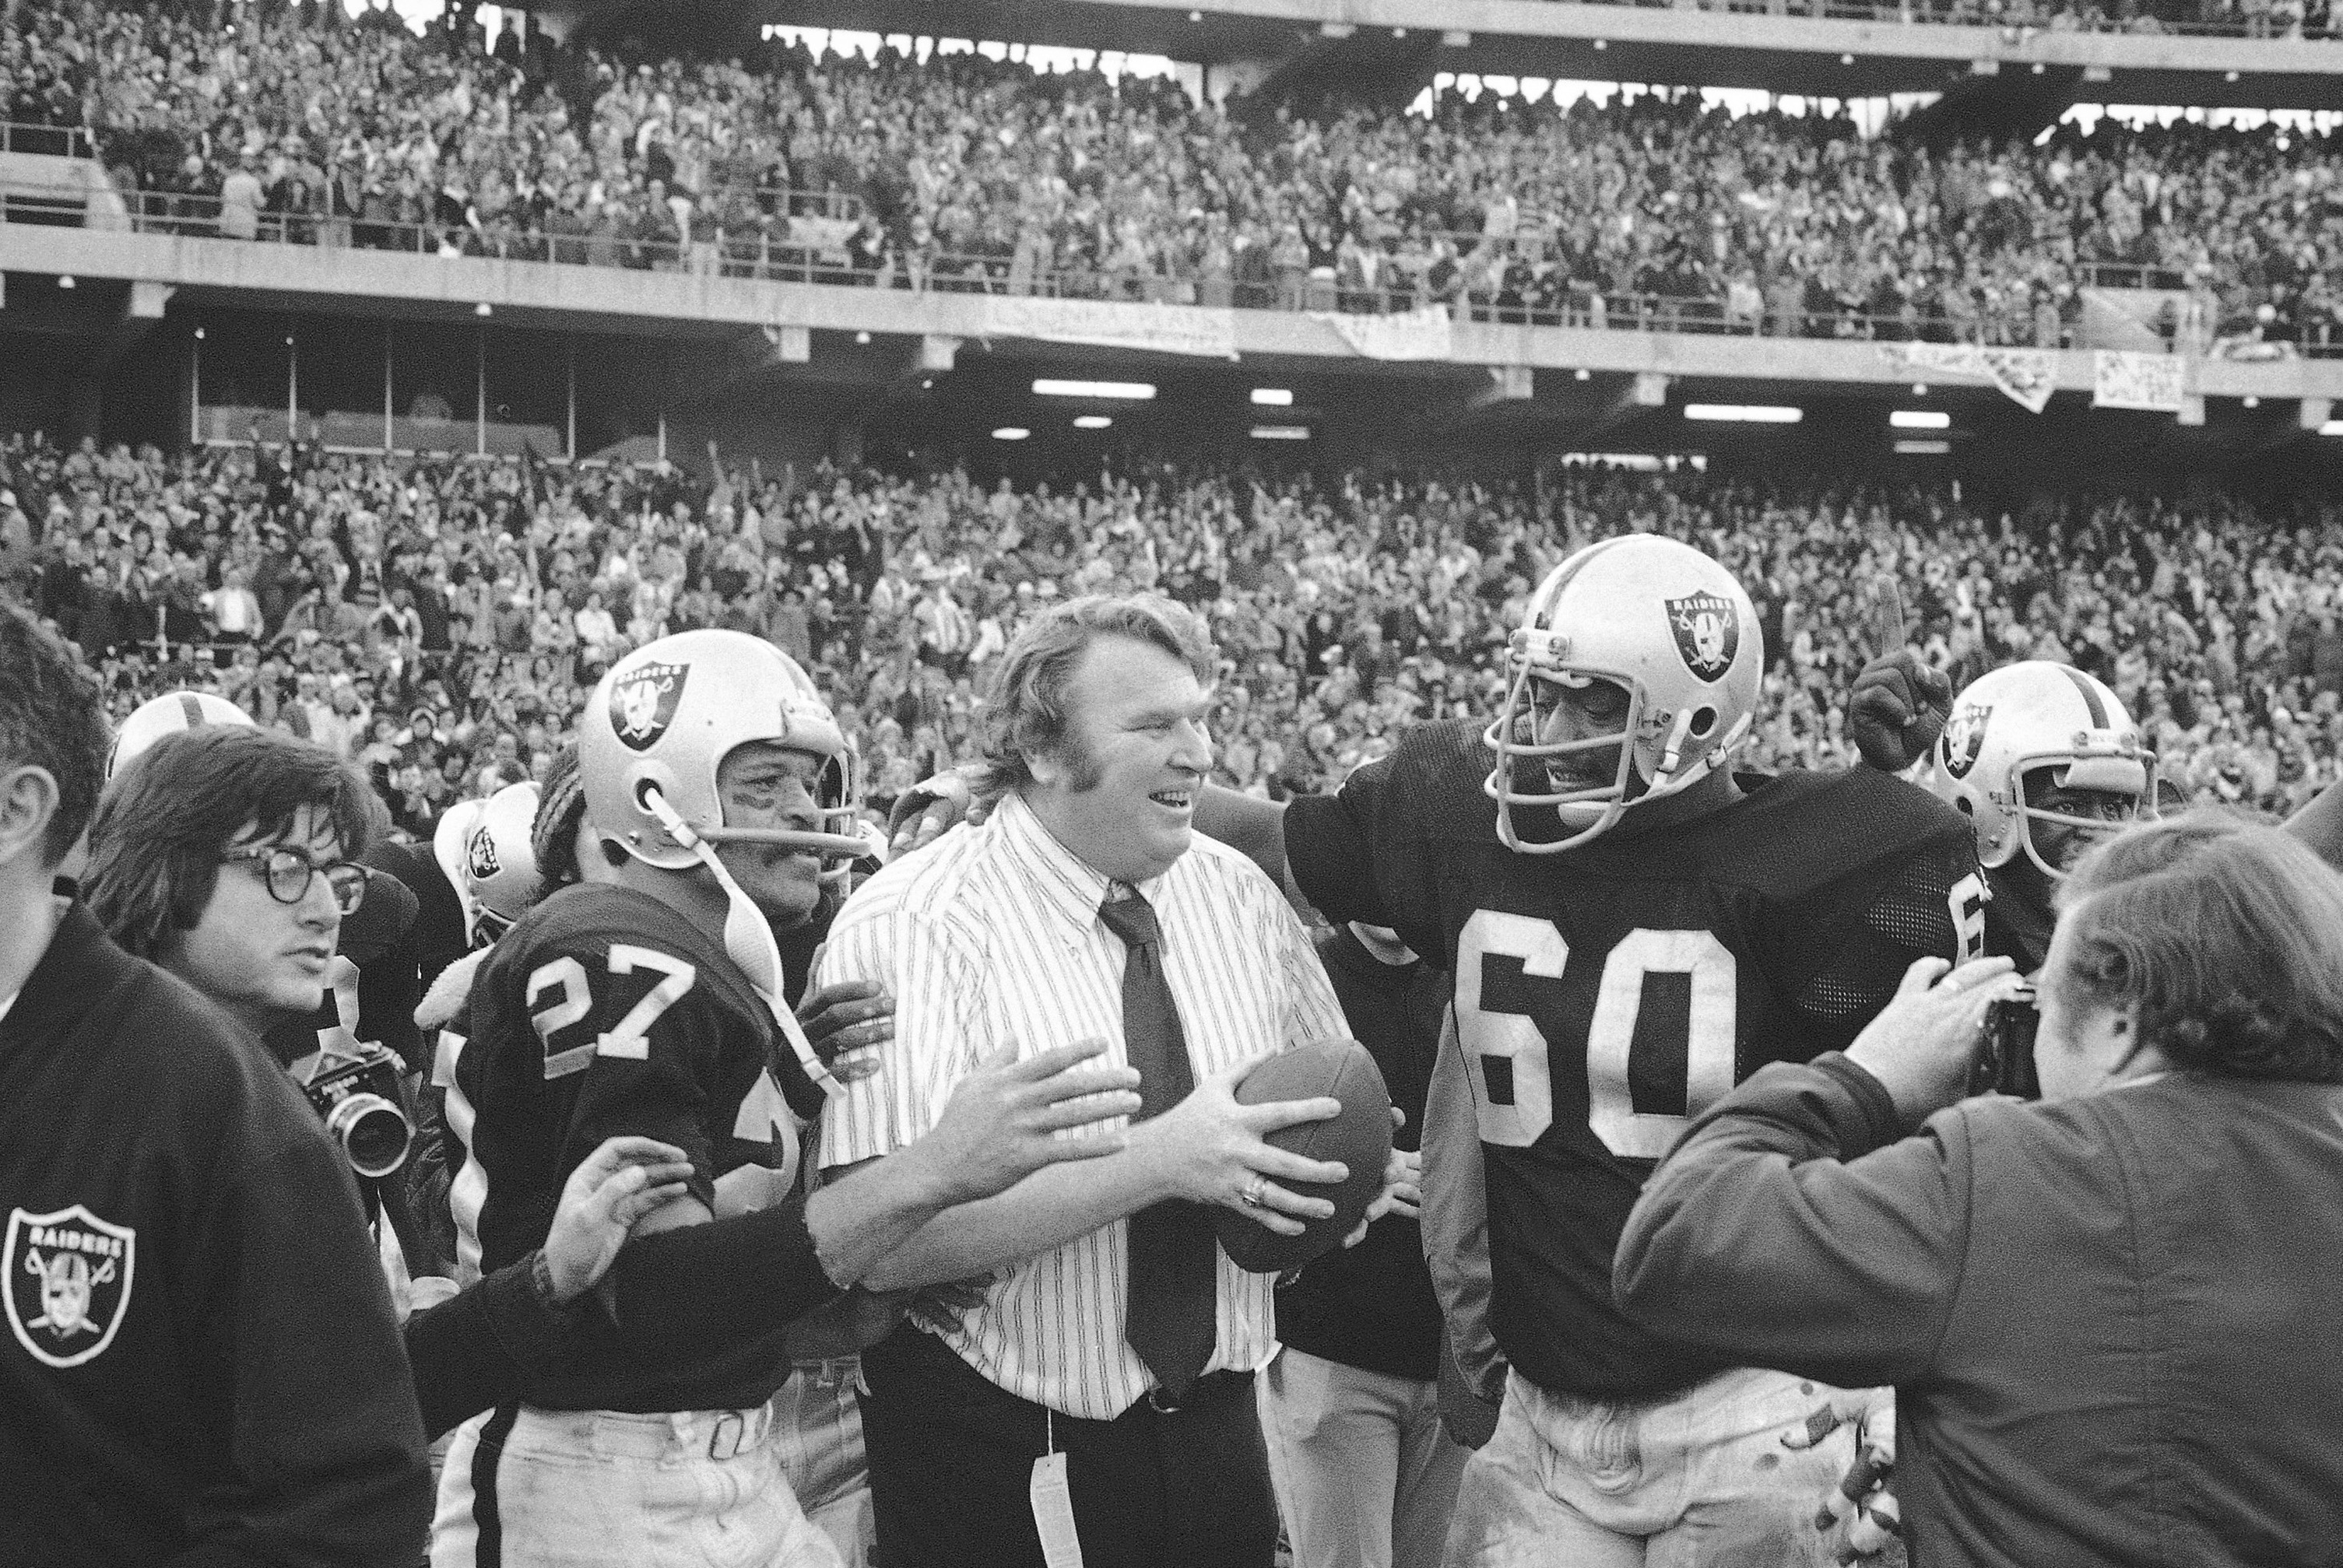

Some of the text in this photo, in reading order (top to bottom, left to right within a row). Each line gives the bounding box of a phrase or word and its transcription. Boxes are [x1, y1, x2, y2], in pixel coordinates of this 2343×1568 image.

[1674, 598, 1732, 610] RAIDERS
[616, 665, 682, 684] RAIDERS
[526, 944, 696, 1080] 27
[1454, 908, 1737, 1159] 60
[29, 1225, 122, 1259] RAIDERS
